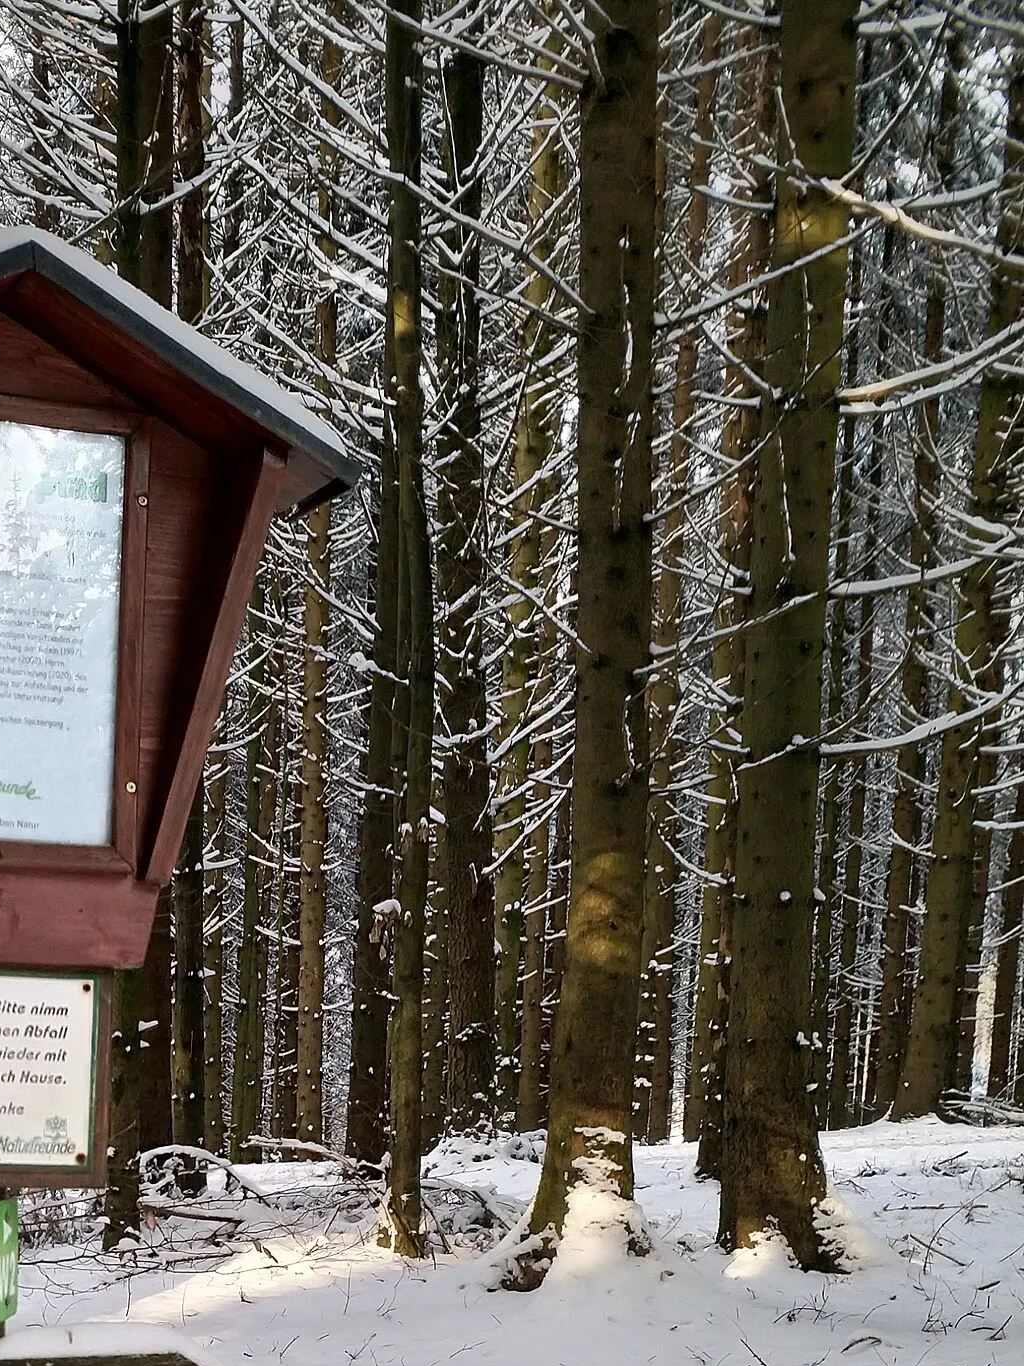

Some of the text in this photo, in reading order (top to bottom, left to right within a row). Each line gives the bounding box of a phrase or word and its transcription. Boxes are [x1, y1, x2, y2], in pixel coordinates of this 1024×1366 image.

[44, 658, 64, 667] Herrn
[63, 684, 74, 693] und
[76, 685, 88, 694] der
[23, 717, 63, 731] Spaziergang
[17, 820, 40, 829] Natur
[30, 1002, 68, 1016] nimm
[25, 1025, 68, 1039] Abfall
[44, 1051, 67, 1062] mit
[20, 1072, 67, 1085] Hause.
